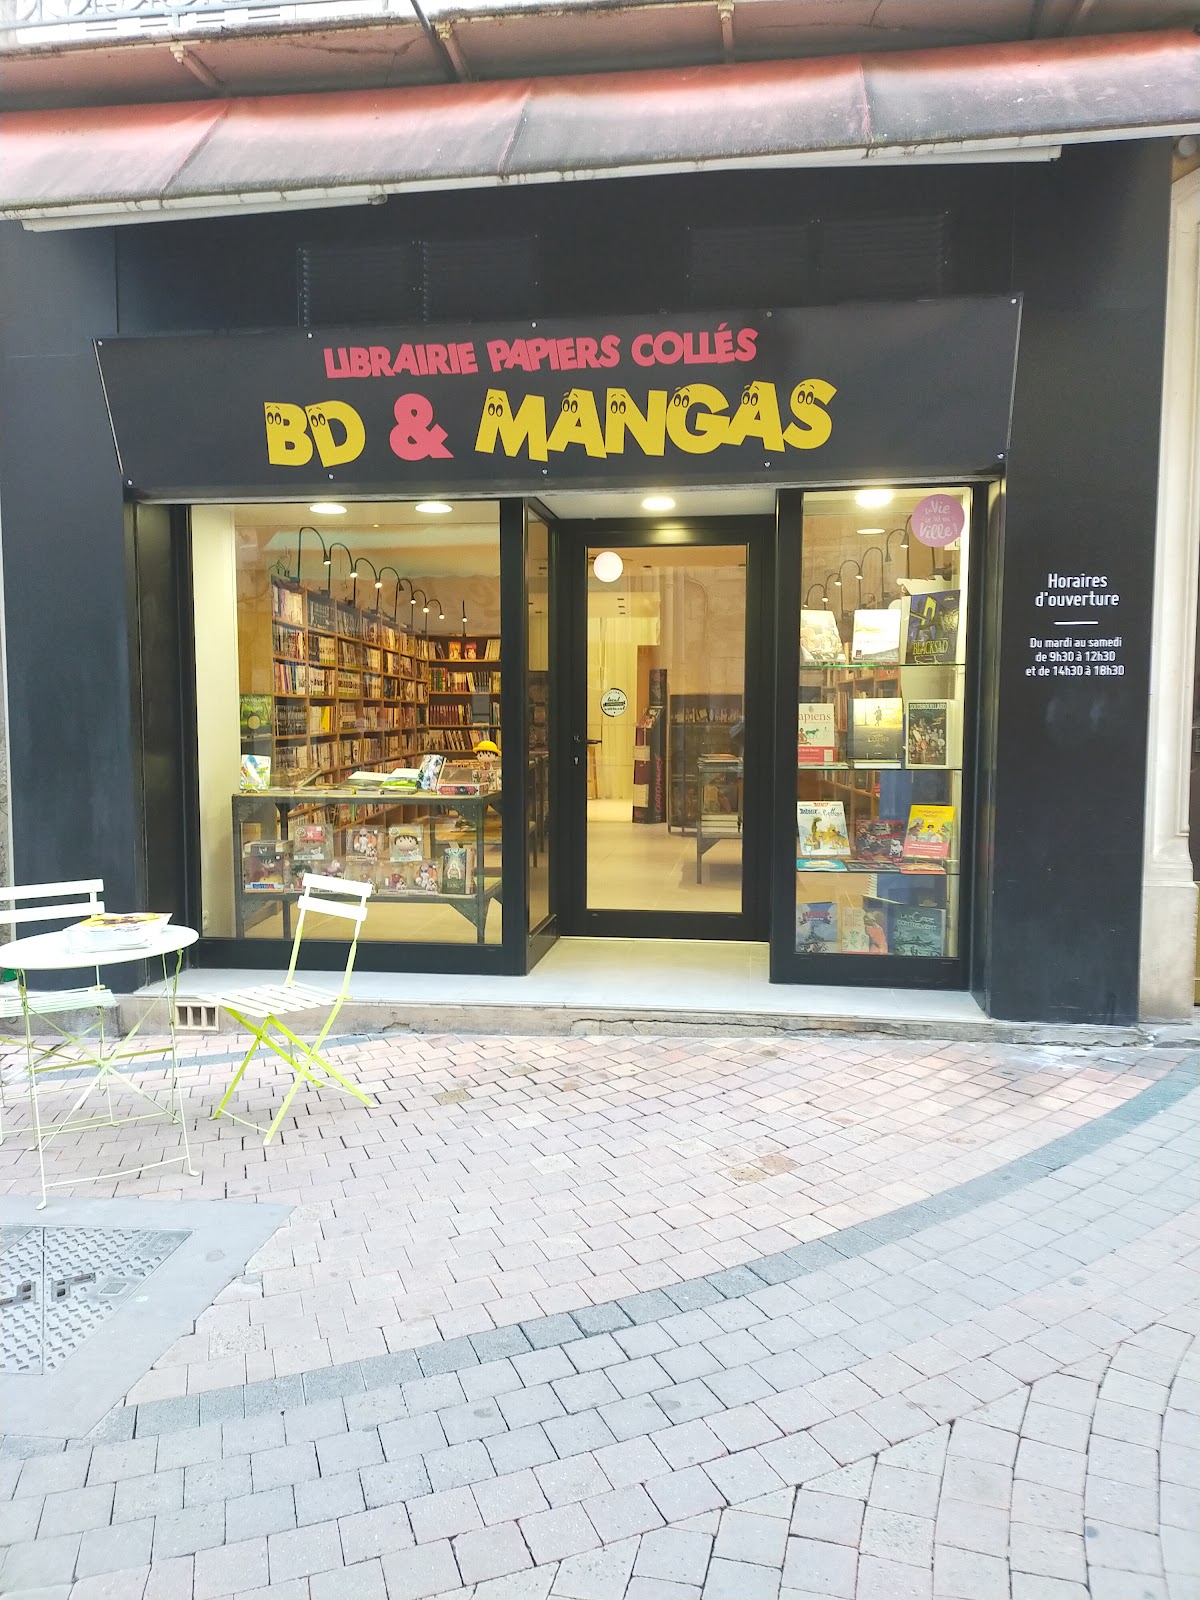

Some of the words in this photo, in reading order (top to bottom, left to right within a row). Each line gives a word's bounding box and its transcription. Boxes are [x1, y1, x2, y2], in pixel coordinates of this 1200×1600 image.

[323, 341, 479, 379] LIBRAIRIE
[486, 335, 621, 374] PAPIERS
[631, 322, 759, 366] COLLÉS
[263, 399, 366, 469] BD
[388, 392, 454, 461] &
[474, 378, 837, 463] MANGAS
[931, 500, 950, 514] Vie
[1047, 573, 1108, 588] Horaires
[1035, 591, 1120, 607] d'ouverture
[1029, 637, 1043, 648] Du
[1044, 637, 1072, 648] mardi
[1074, 639, 1086, 648] au
[1087, 636, 1123, 648] samedi
[1035, 652, 1048, 662] de
[1048, 651, 1074, 662] 9h30
[1075, 651, 1082, 662] à
[1085, 650, 1116, 662] 12h30
[1025, 666, 1036, 677] et
[1038, 665, 1050, 676] de
[1053, 665, 1083, 676] 14h30
[1084, 665, 1091, 676] à
[1094, 665, 1125, 676] 18h30
[799, 713, 832, 724] apiens
